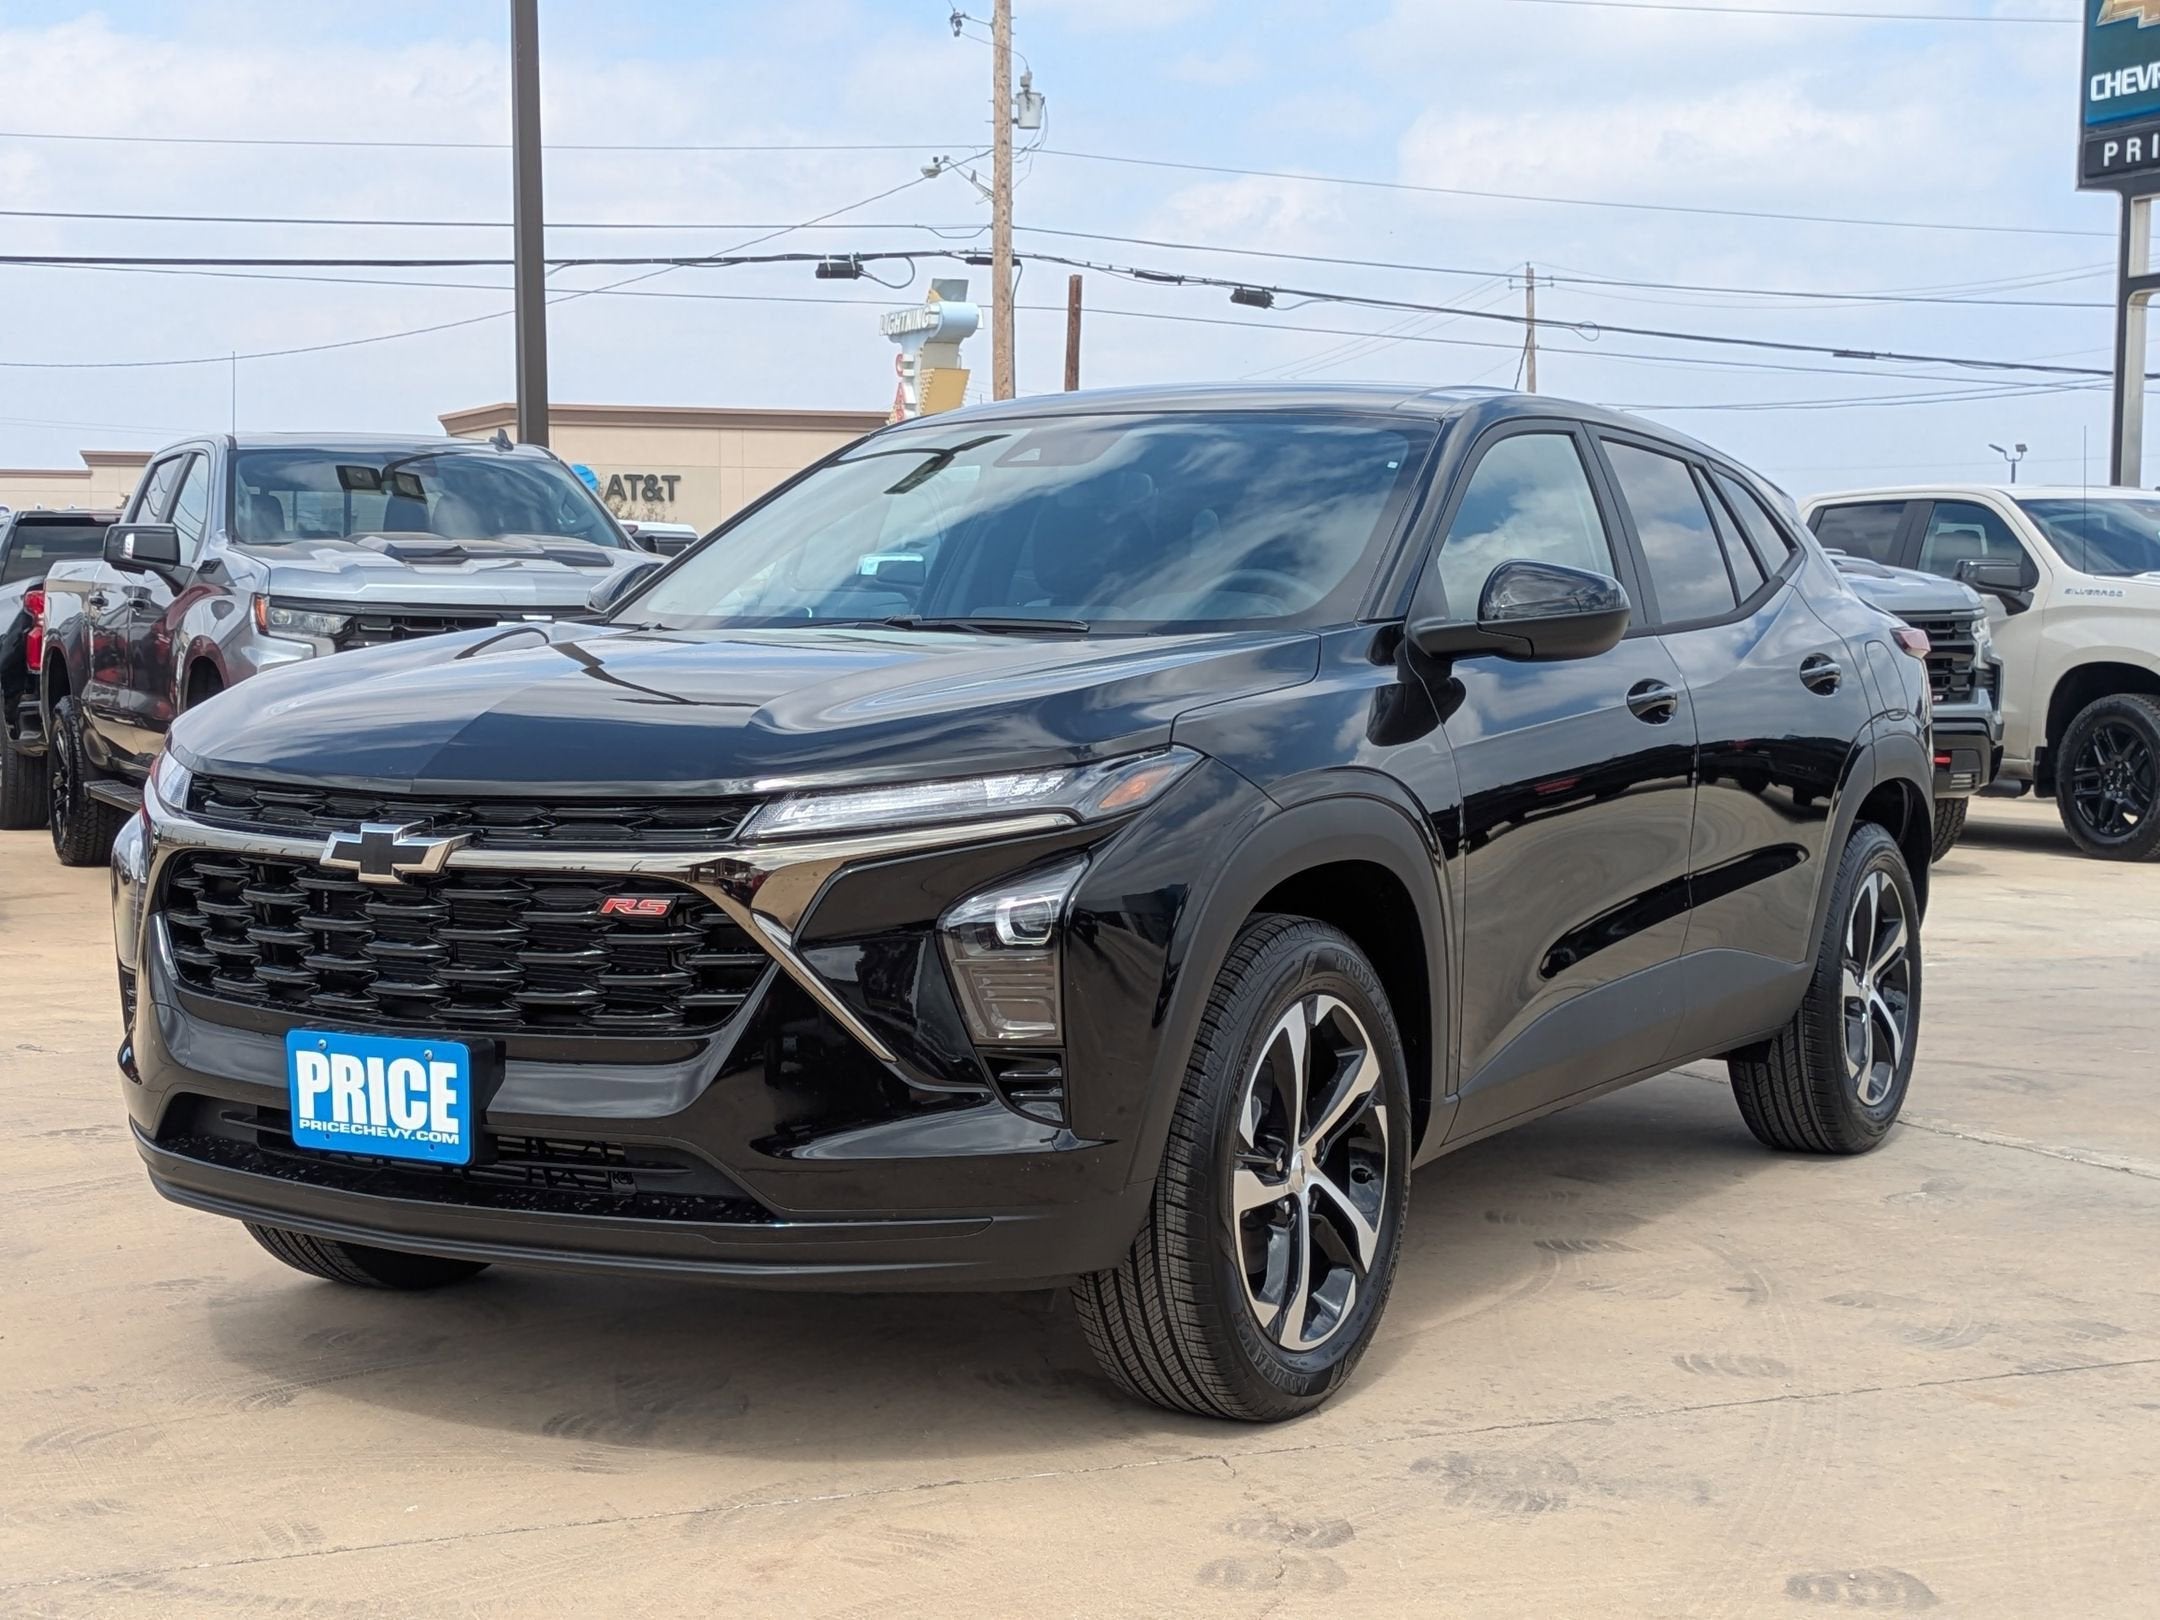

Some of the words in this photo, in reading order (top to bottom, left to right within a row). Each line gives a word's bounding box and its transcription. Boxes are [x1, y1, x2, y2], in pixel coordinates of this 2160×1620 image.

[2103, 133, 2160, 167] PRI
[879, 305, 932, 336] LIGHTNING
[604, 474, 681, 502] AT&T
[600, 898, 671, 915] RS
[296, 1050, 459, 1133] PRICE
[299, 1119, 460, 1144] PRICECHEVY.COM
